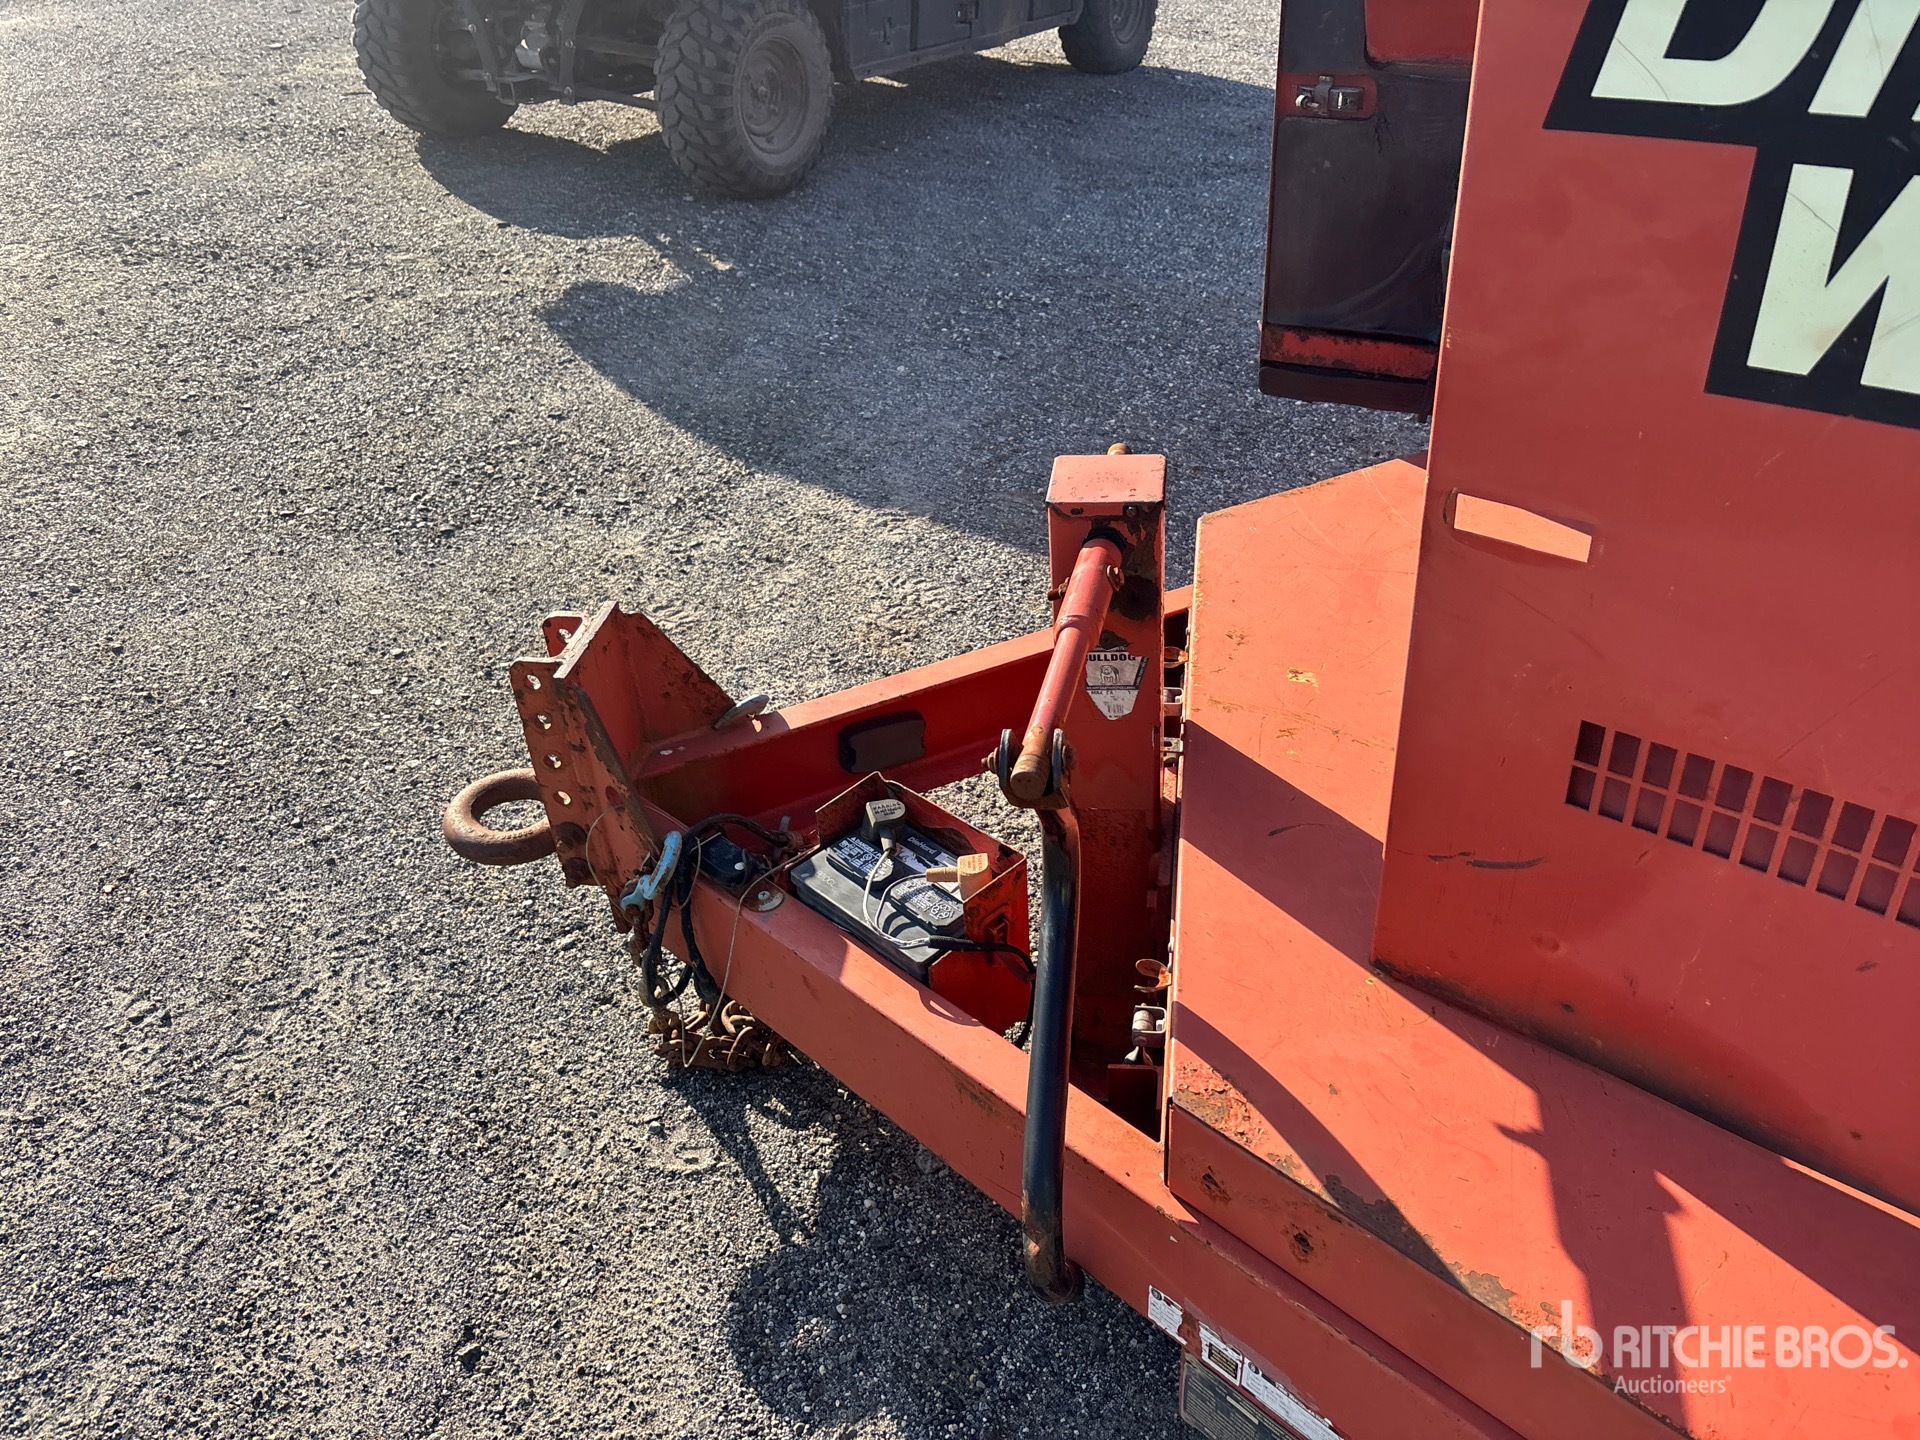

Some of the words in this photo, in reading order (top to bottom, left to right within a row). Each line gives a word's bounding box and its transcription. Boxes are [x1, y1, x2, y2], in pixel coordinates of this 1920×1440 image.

[1591, 0, 1920, 122] DI
[1086, 653, 1136, 662] ULLDOG
[907, 836, 937, 855] DieHard
